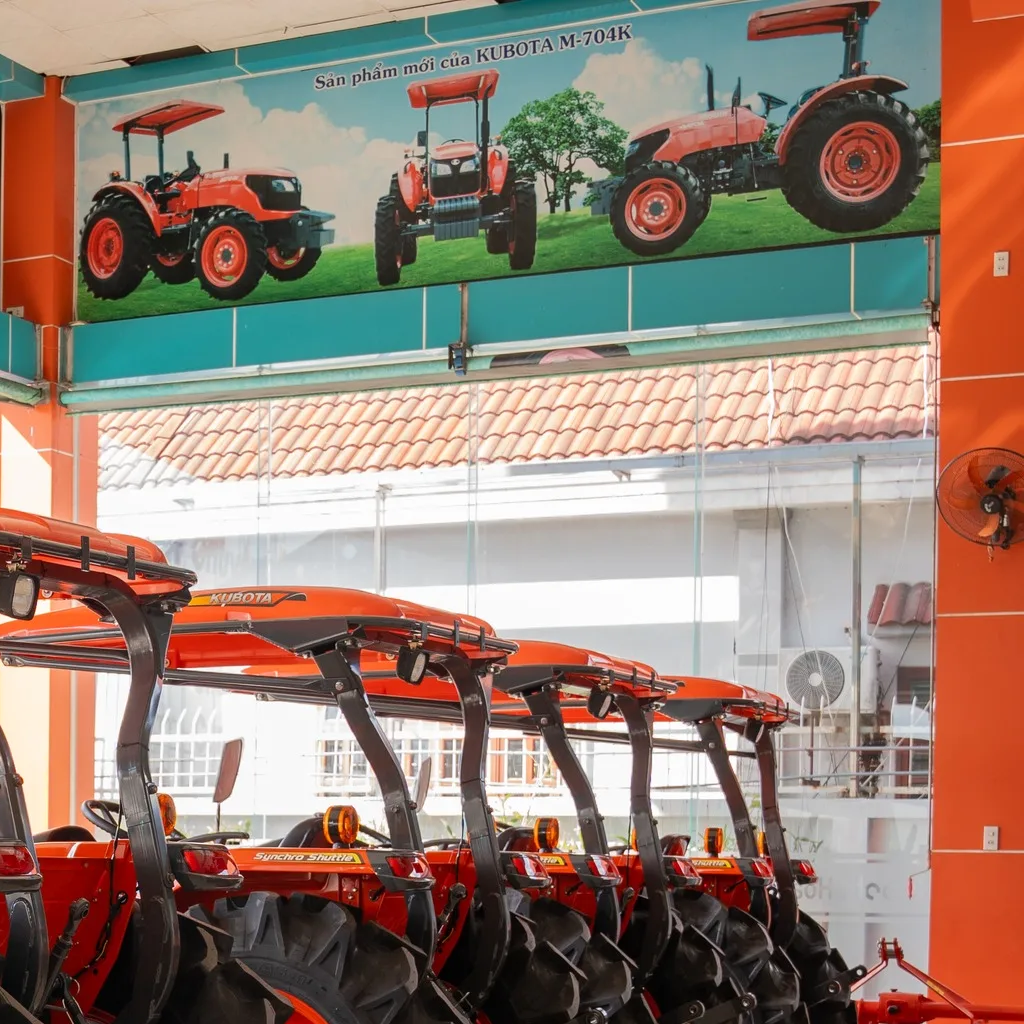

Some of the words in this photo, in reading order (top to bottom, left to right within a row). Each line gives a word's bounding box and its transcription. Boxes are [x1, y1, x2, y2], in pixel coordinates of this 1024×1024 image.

[314, 68, 347, 90] Sản
[352, 61, 397, 88] phẩm
[403, 55, 435, 75] mới
[440, 53, 471, 71] của
[476, 37, 555, 65] KUBOTA
[558, 23, 632, 49] M-704K
[209, 592, 273, 604] KUBOTA
[254, 852, 305, 862] Synchro
[307, 852, 353, 862] Shuttle
